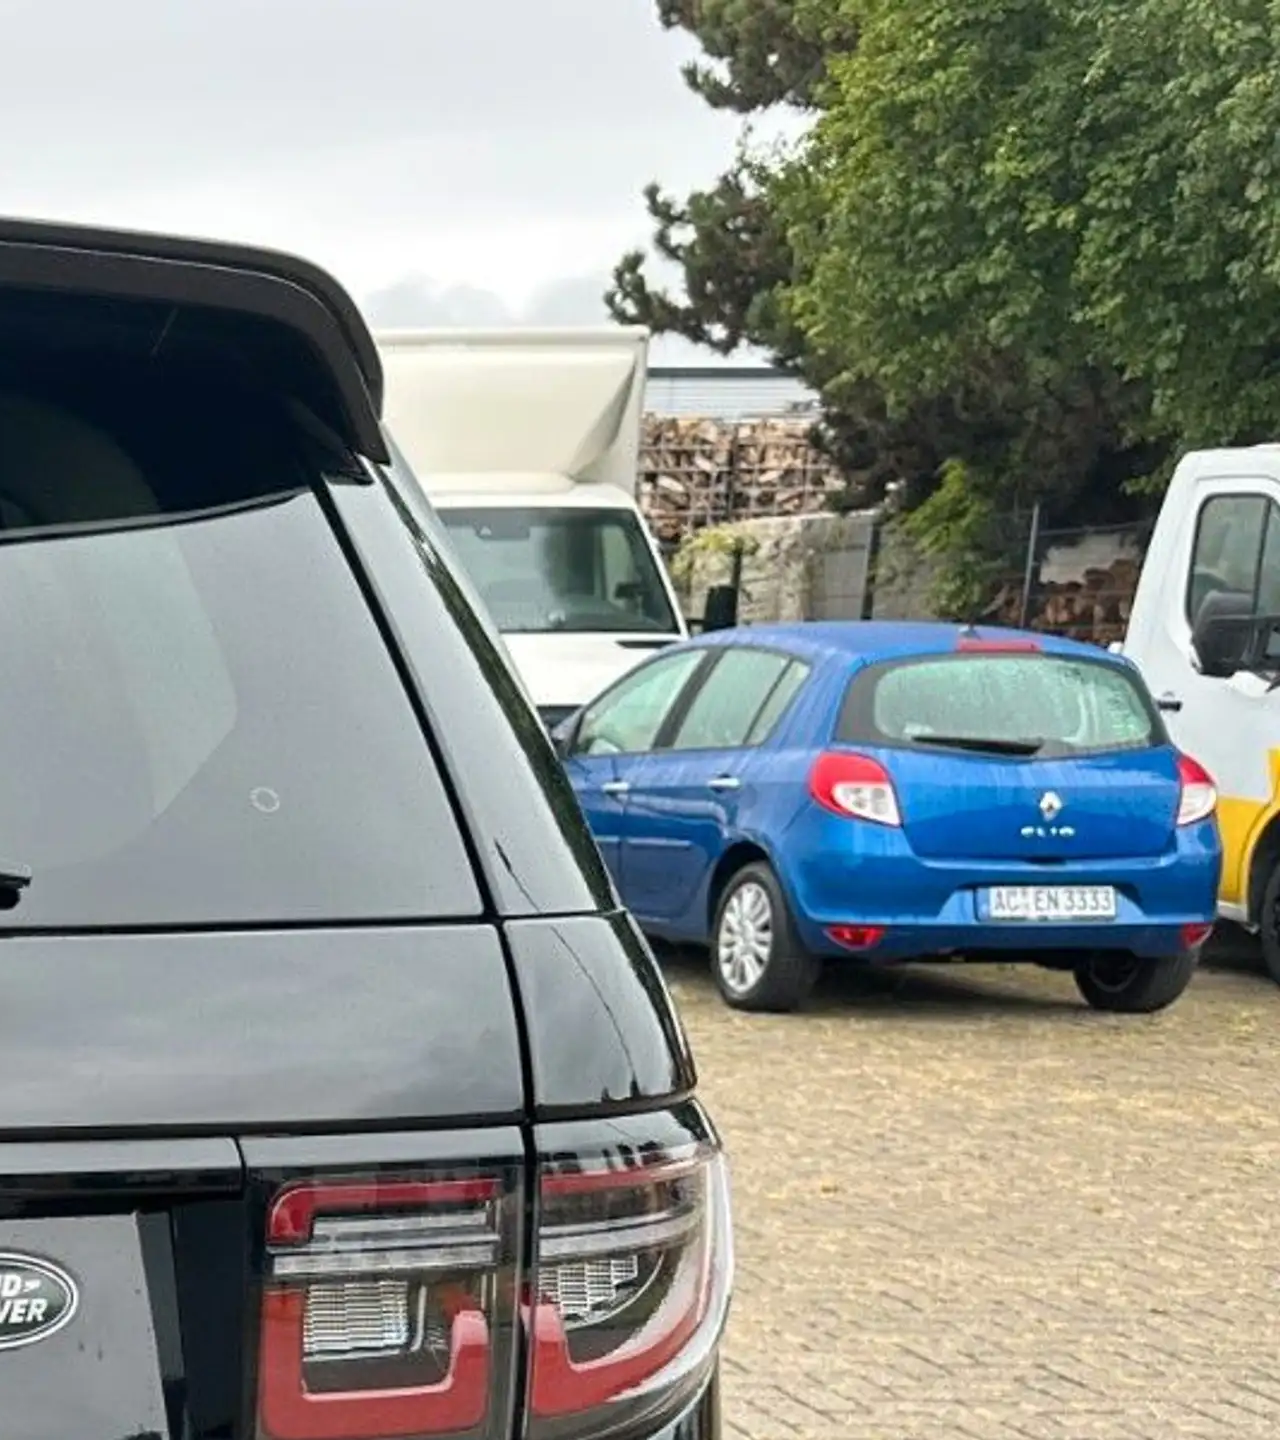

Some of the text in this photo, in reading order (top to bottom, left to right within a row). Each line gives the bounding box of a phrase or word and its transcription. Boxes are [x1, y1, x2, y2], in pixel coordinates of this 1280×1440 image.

[994, 888, 1113, 911] AC EN 3333
